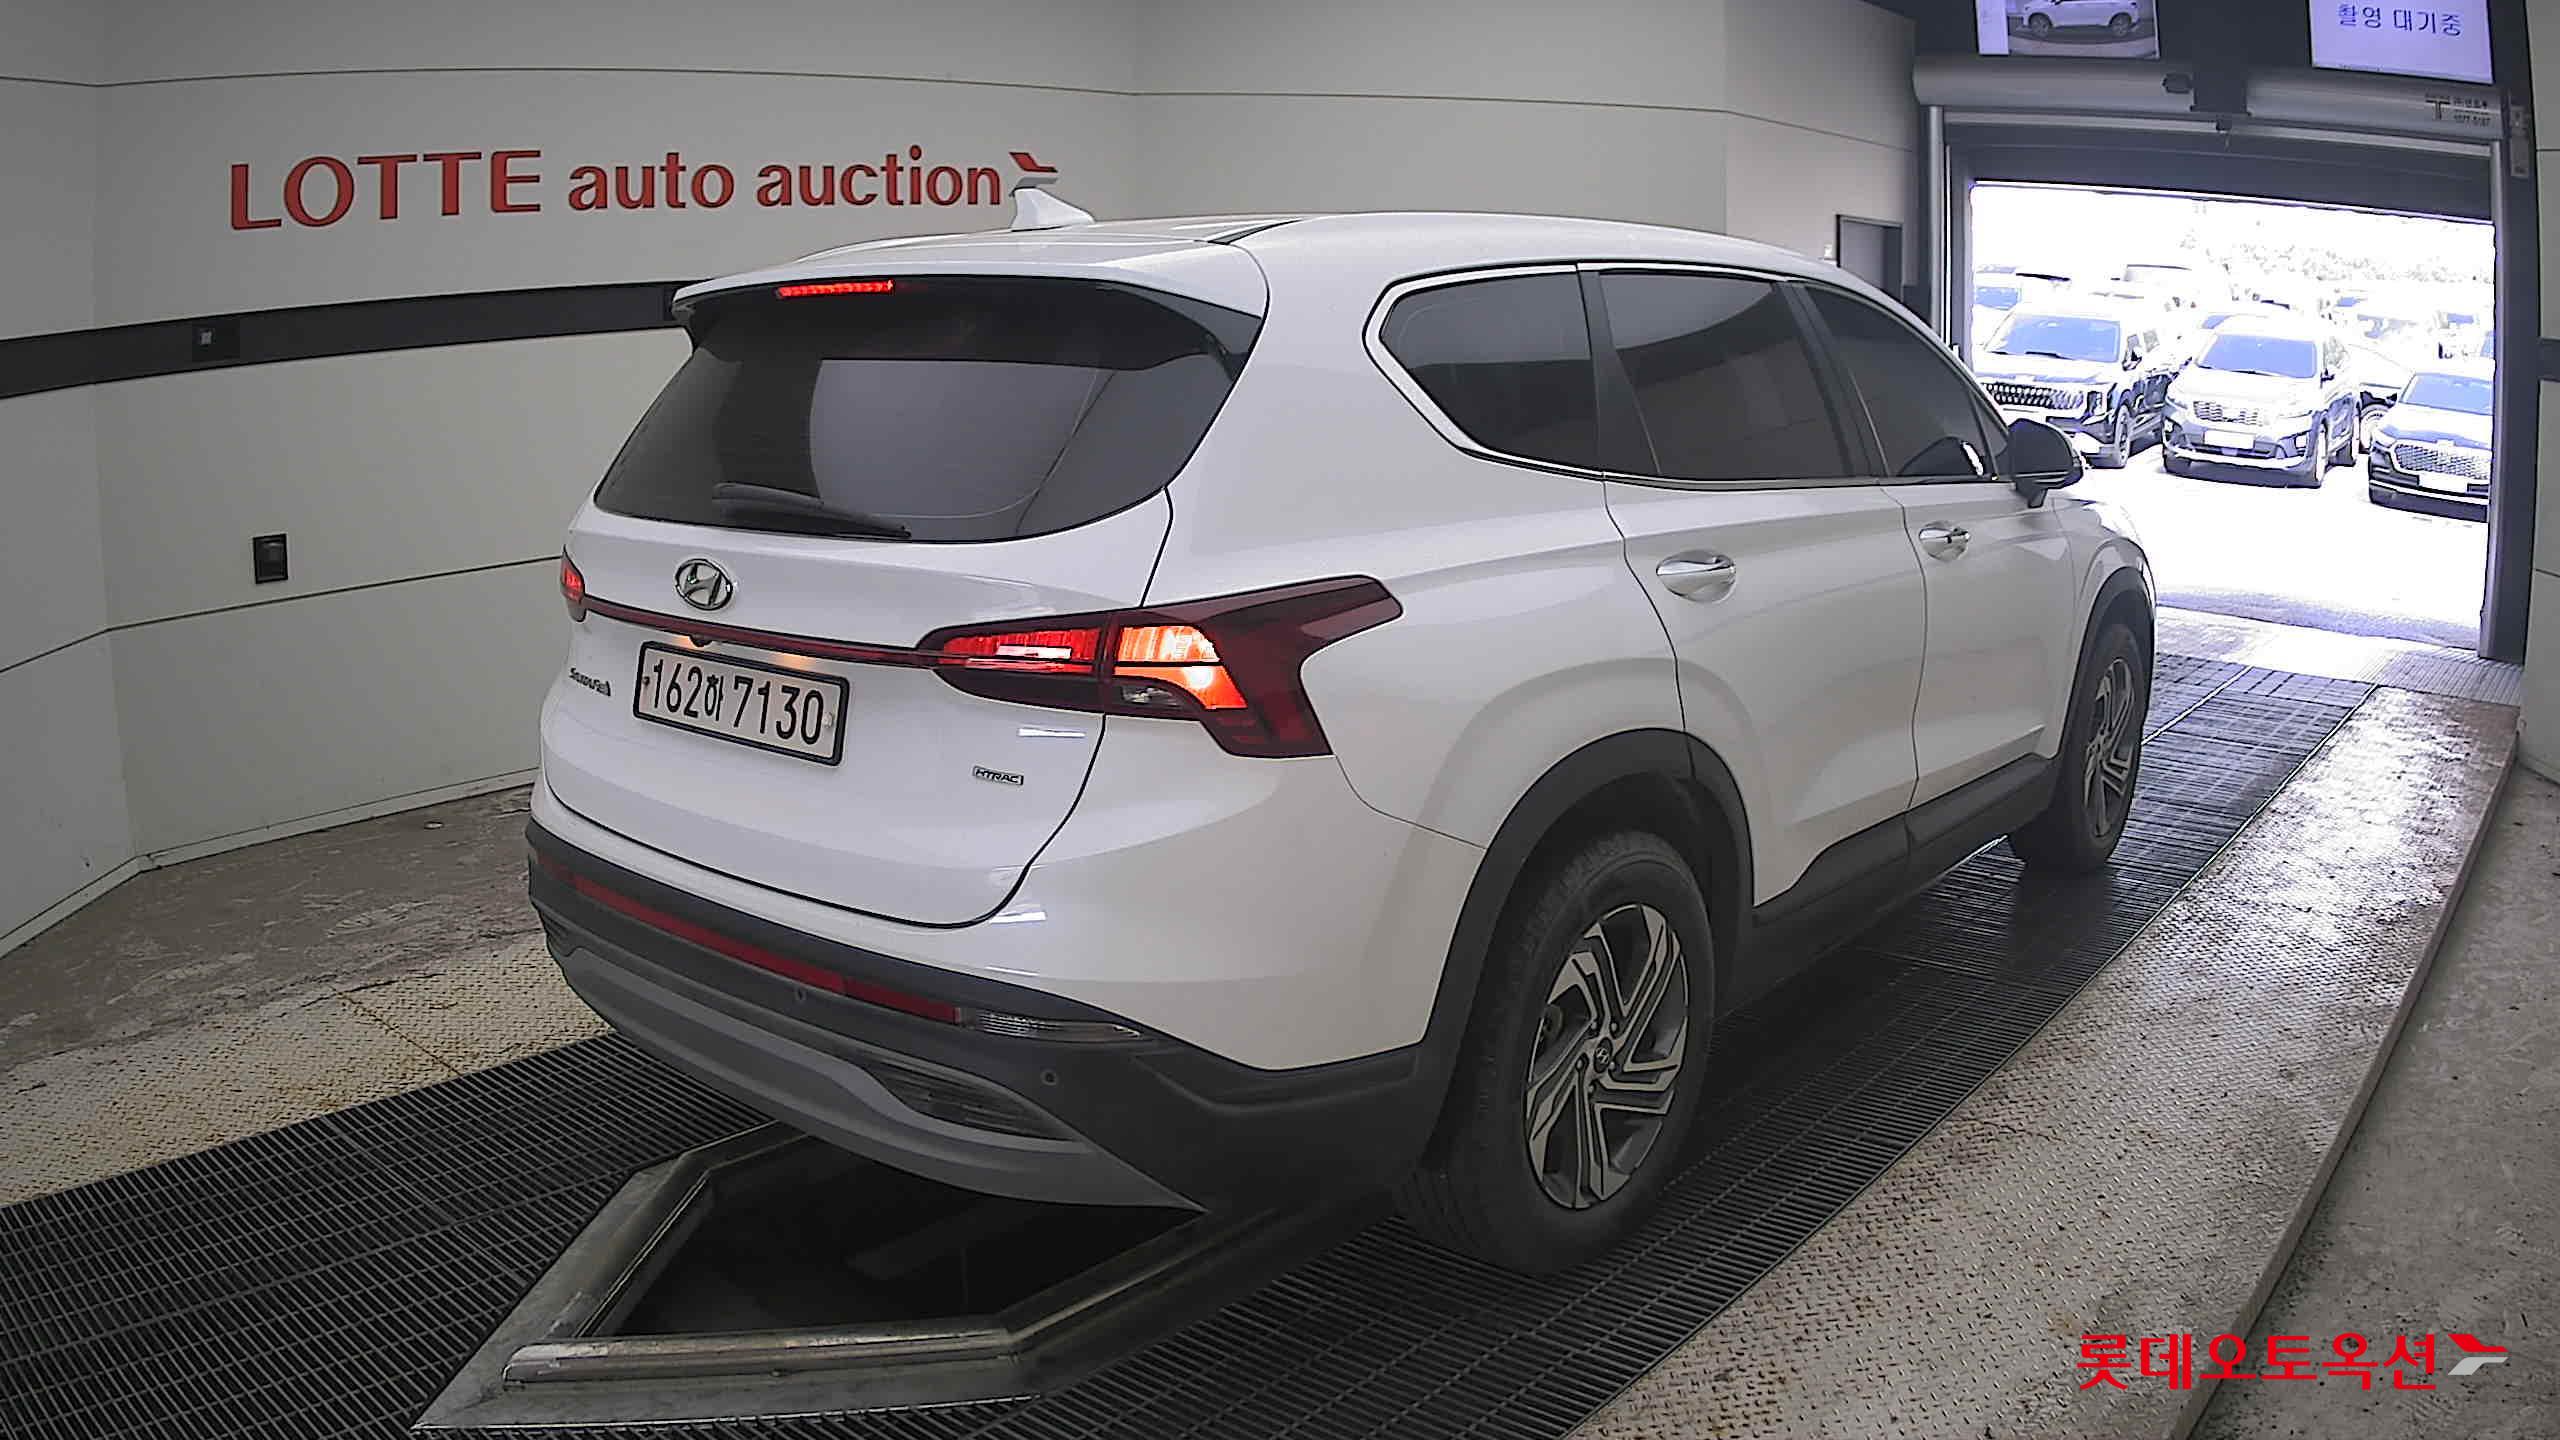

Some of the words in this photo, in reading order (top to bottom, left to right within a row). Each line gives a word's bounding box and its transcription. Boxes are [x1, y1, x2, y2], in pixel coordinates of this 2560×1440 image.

[2393, 8, 2461, 37] 대기중
[230, 149, 542, 231] LOTTE
[567, 152, 736, 211] auto
[756, 144, 1001, 208] auction
[653, 659, 725, 722] 162하
[733, 674, 824, 745] 7130
